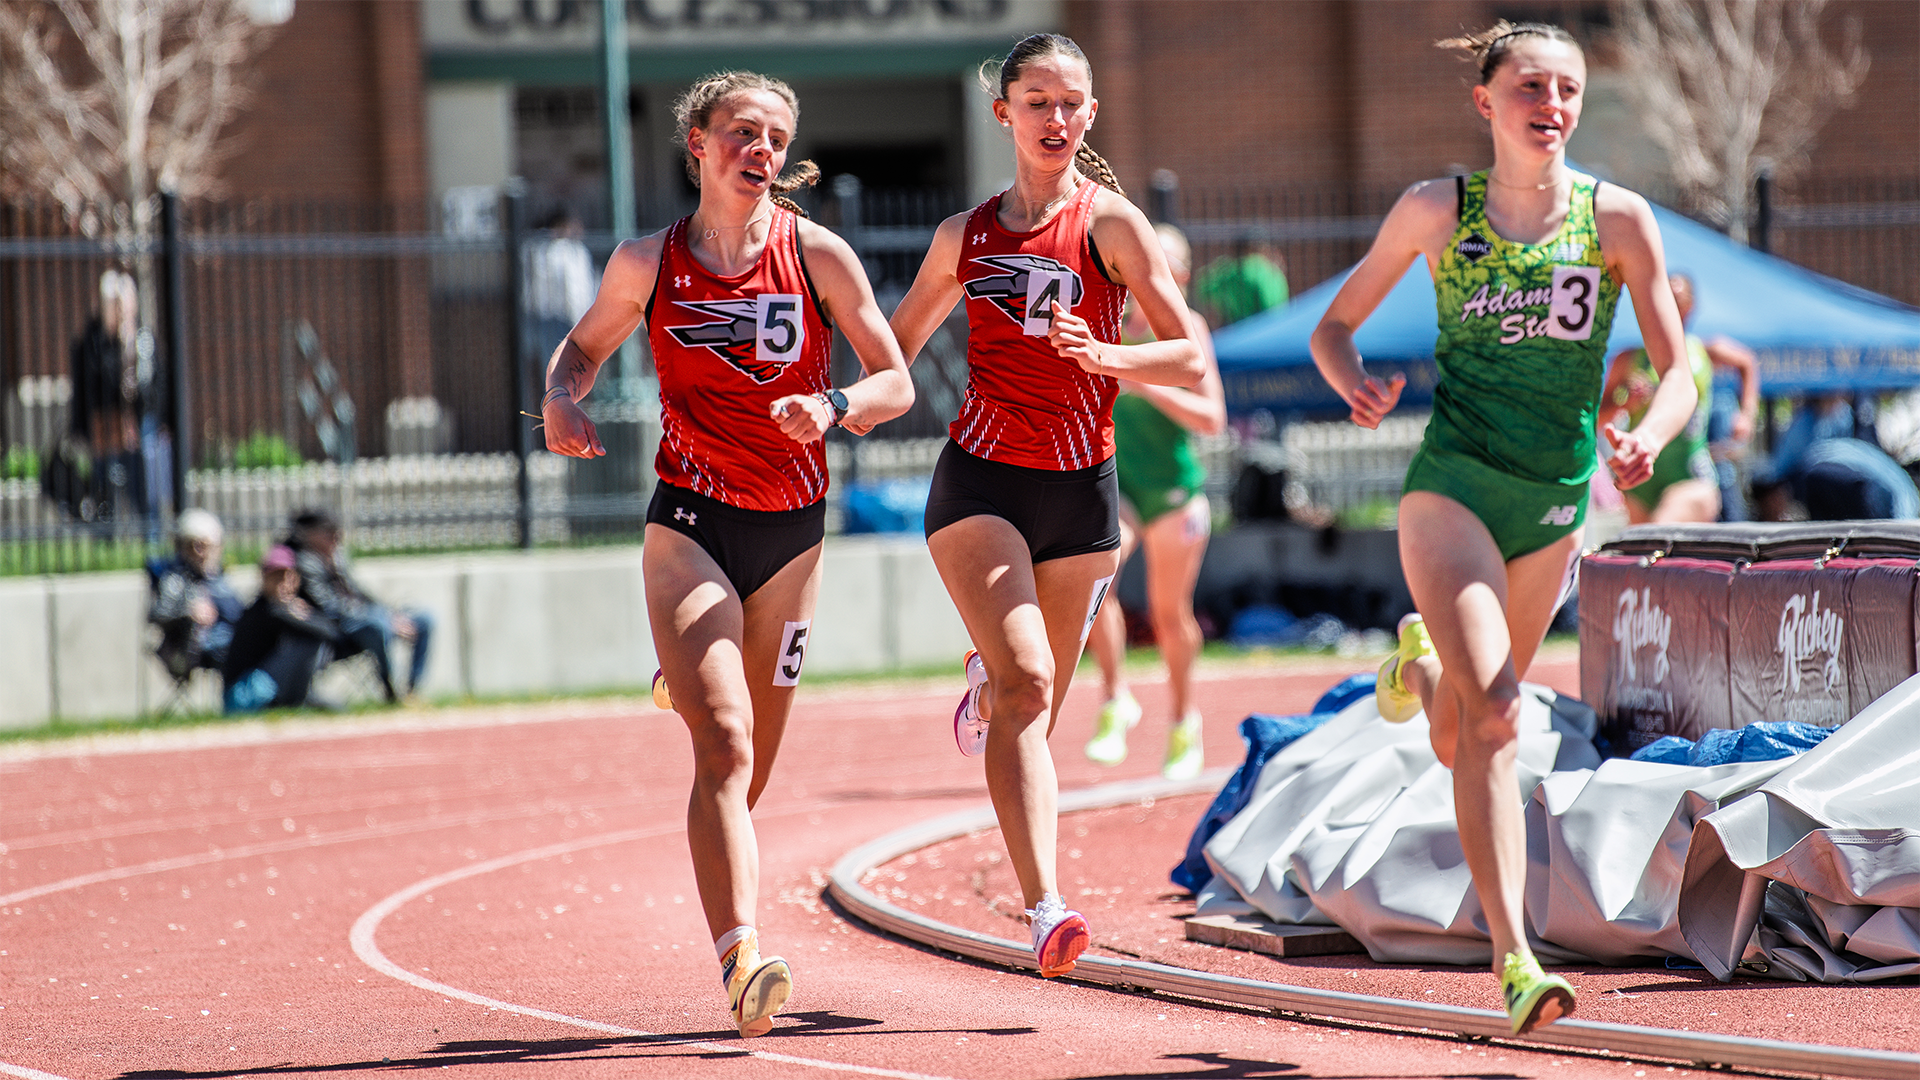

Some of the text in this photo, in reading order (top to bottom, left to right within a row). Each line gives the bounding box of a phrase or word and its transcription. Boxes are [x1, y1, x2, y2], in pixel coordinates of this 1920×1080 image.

[763, 302, 797, 353] 5
[1028, 278, 1061, 329] 4
[1461, 282, 1552, 322] Adam
[1557, 276, 1592, 332] 3
[1500, 313, 1551, 344] Sta
[782, 627, 808, 680] 5
[1778, 590, 1844, 700] Richey
